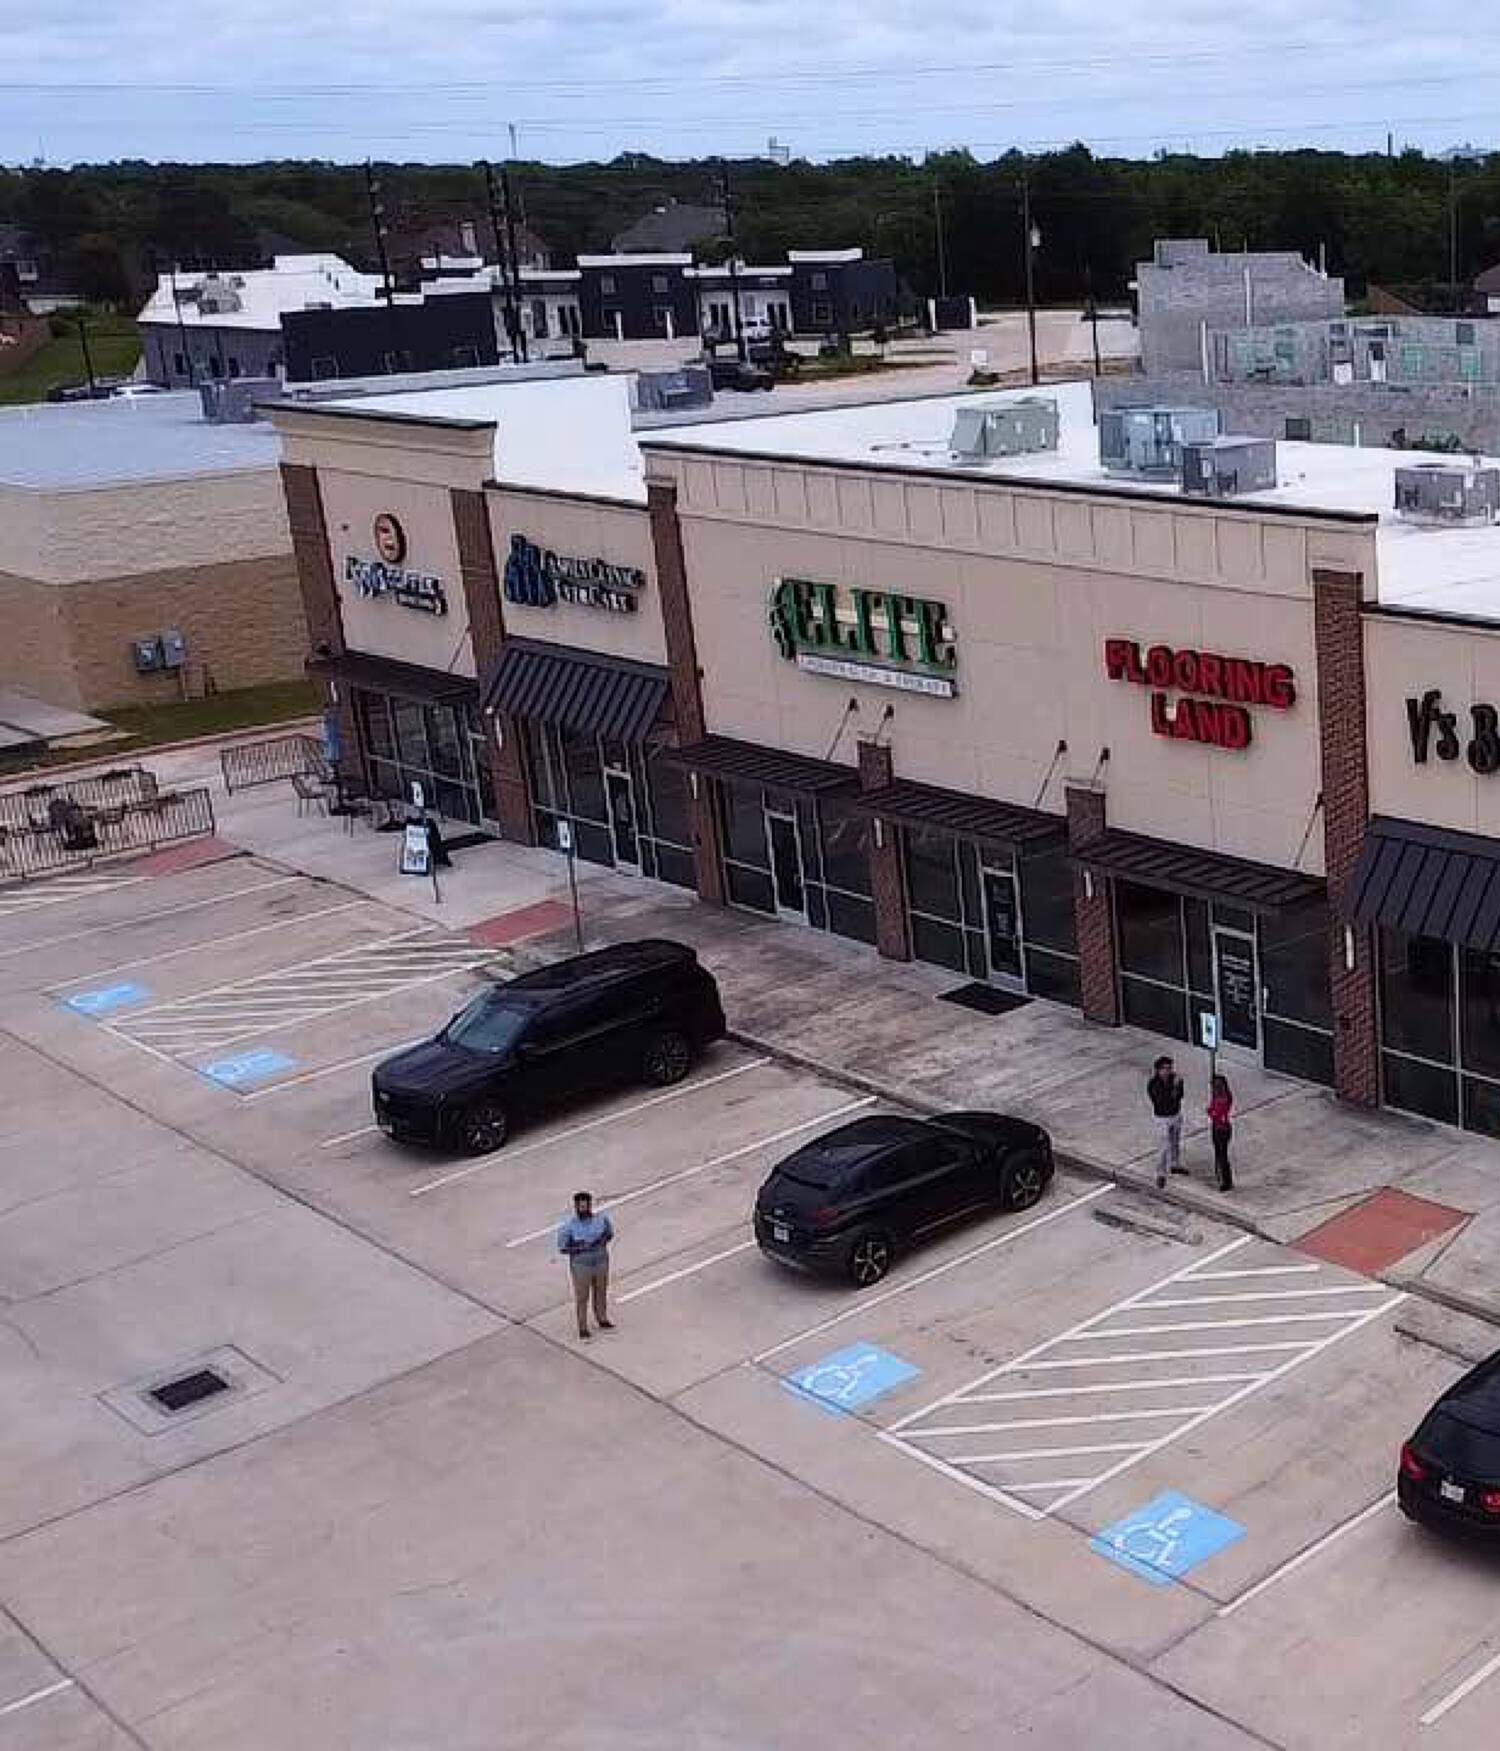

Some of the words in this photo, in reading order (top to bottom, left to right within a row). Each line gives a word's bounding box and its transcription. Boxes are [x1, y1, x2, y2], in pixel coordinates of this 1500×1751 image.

[1105, 640, 1296, 708] FLOORING
[1151, 691, 1252, 748] LAND
[1405, 690, 1459, 763] V's
